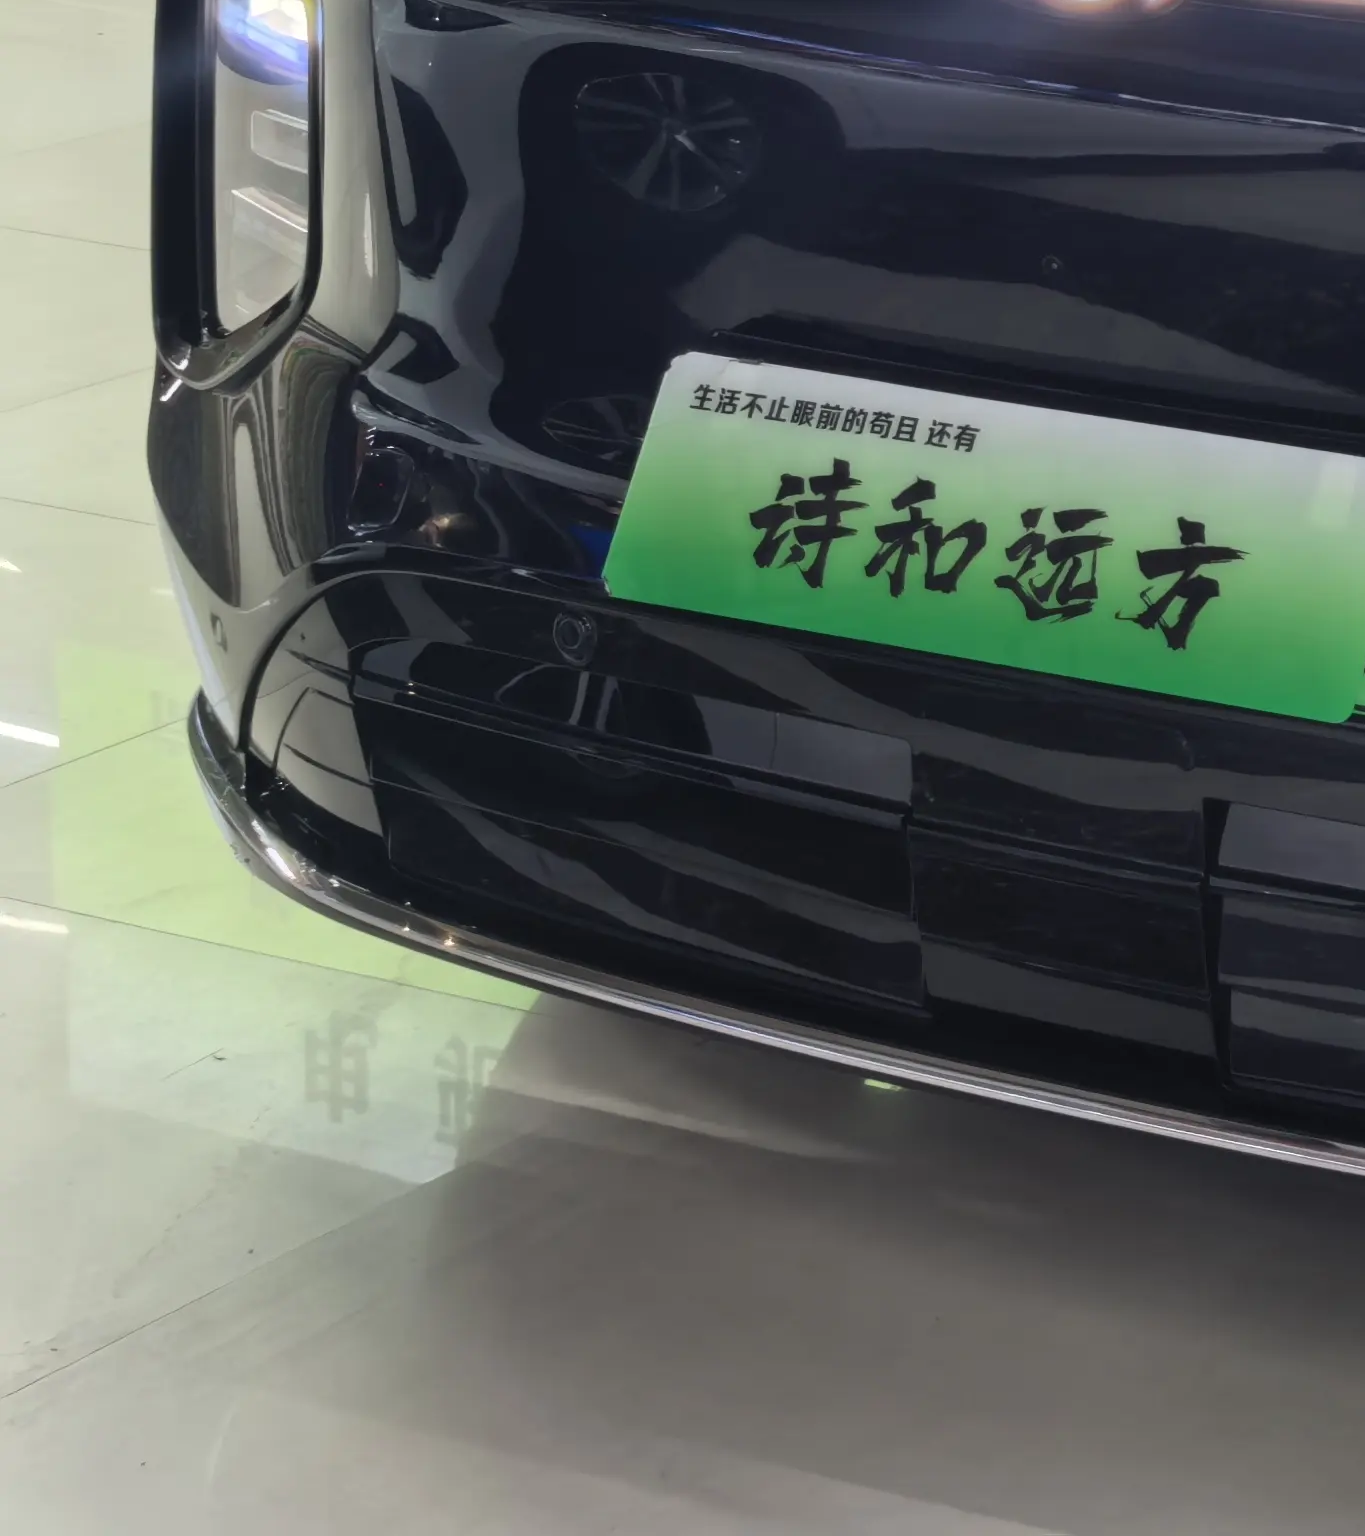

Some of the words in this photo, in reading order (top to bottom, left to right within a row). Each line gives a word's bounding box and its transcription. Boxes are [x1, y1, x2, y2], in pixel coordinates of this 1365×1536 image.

[690, 383, 920, 444] 生活不止眼前的苟且
[924, 419, 981, 454] 还有
[749, 457, 1250, 651] 诗和远方
